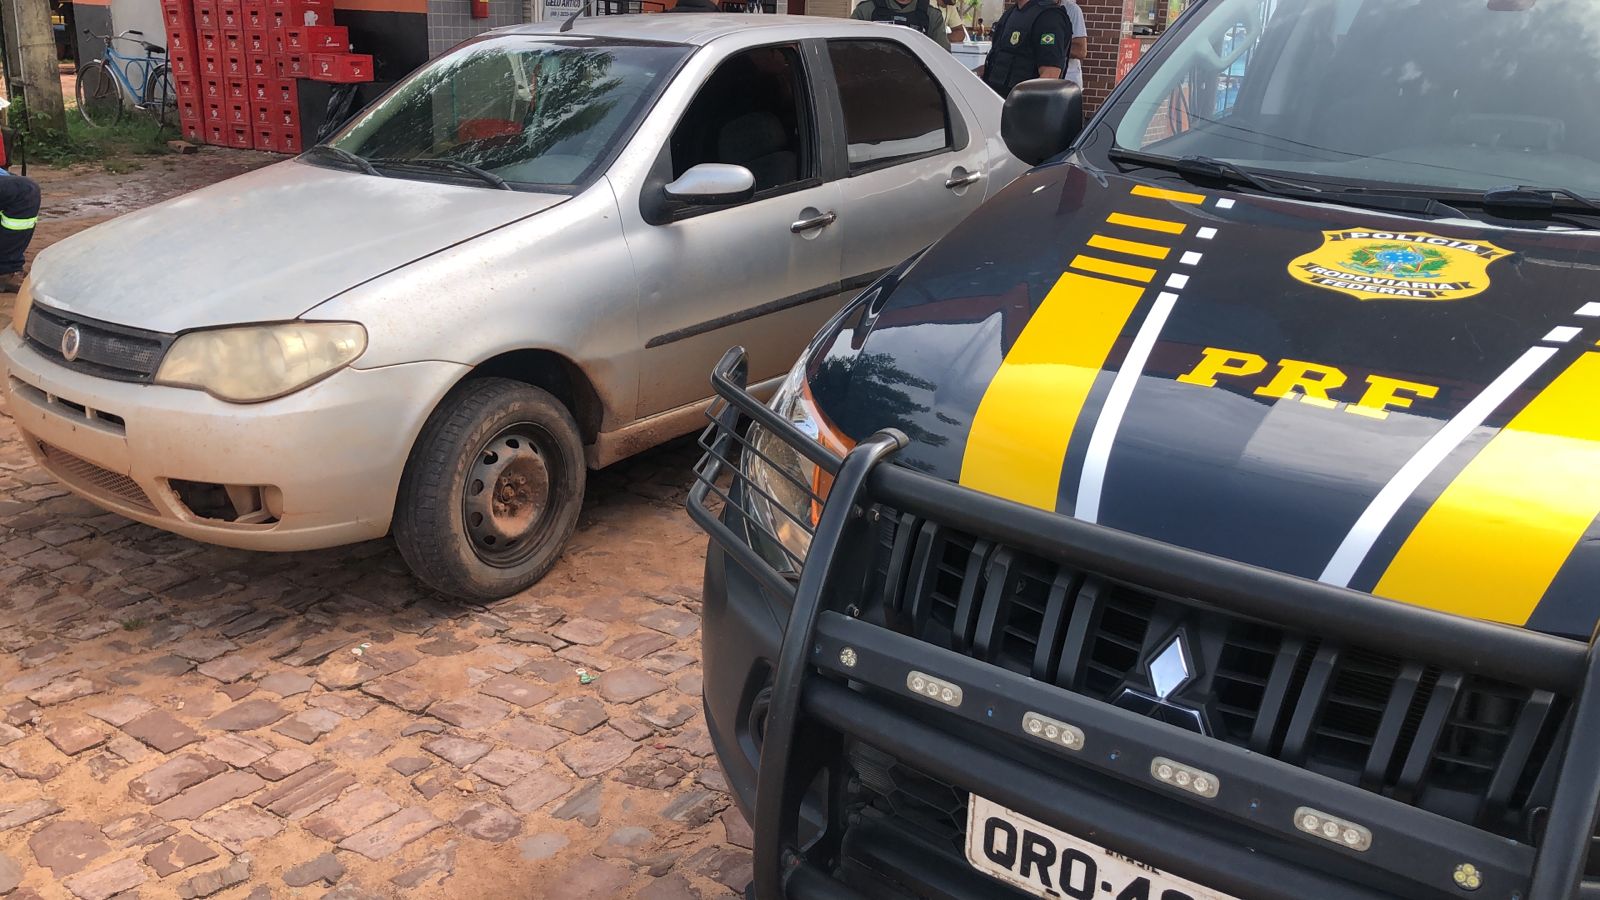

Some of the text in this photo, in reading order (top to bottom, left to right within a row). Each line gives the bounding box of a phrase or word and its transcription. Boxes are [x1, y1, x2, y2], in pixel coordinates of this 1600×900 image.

[1350, 232, 1479, 252] POLICIA
[1310, 265, 1455, 290] RODOVIARIA
[1319, 278, 1427, 298] FEDERAL
[1176, 347, 1440, 420] PRF
[983, 816, 1196, 900] QRO-
